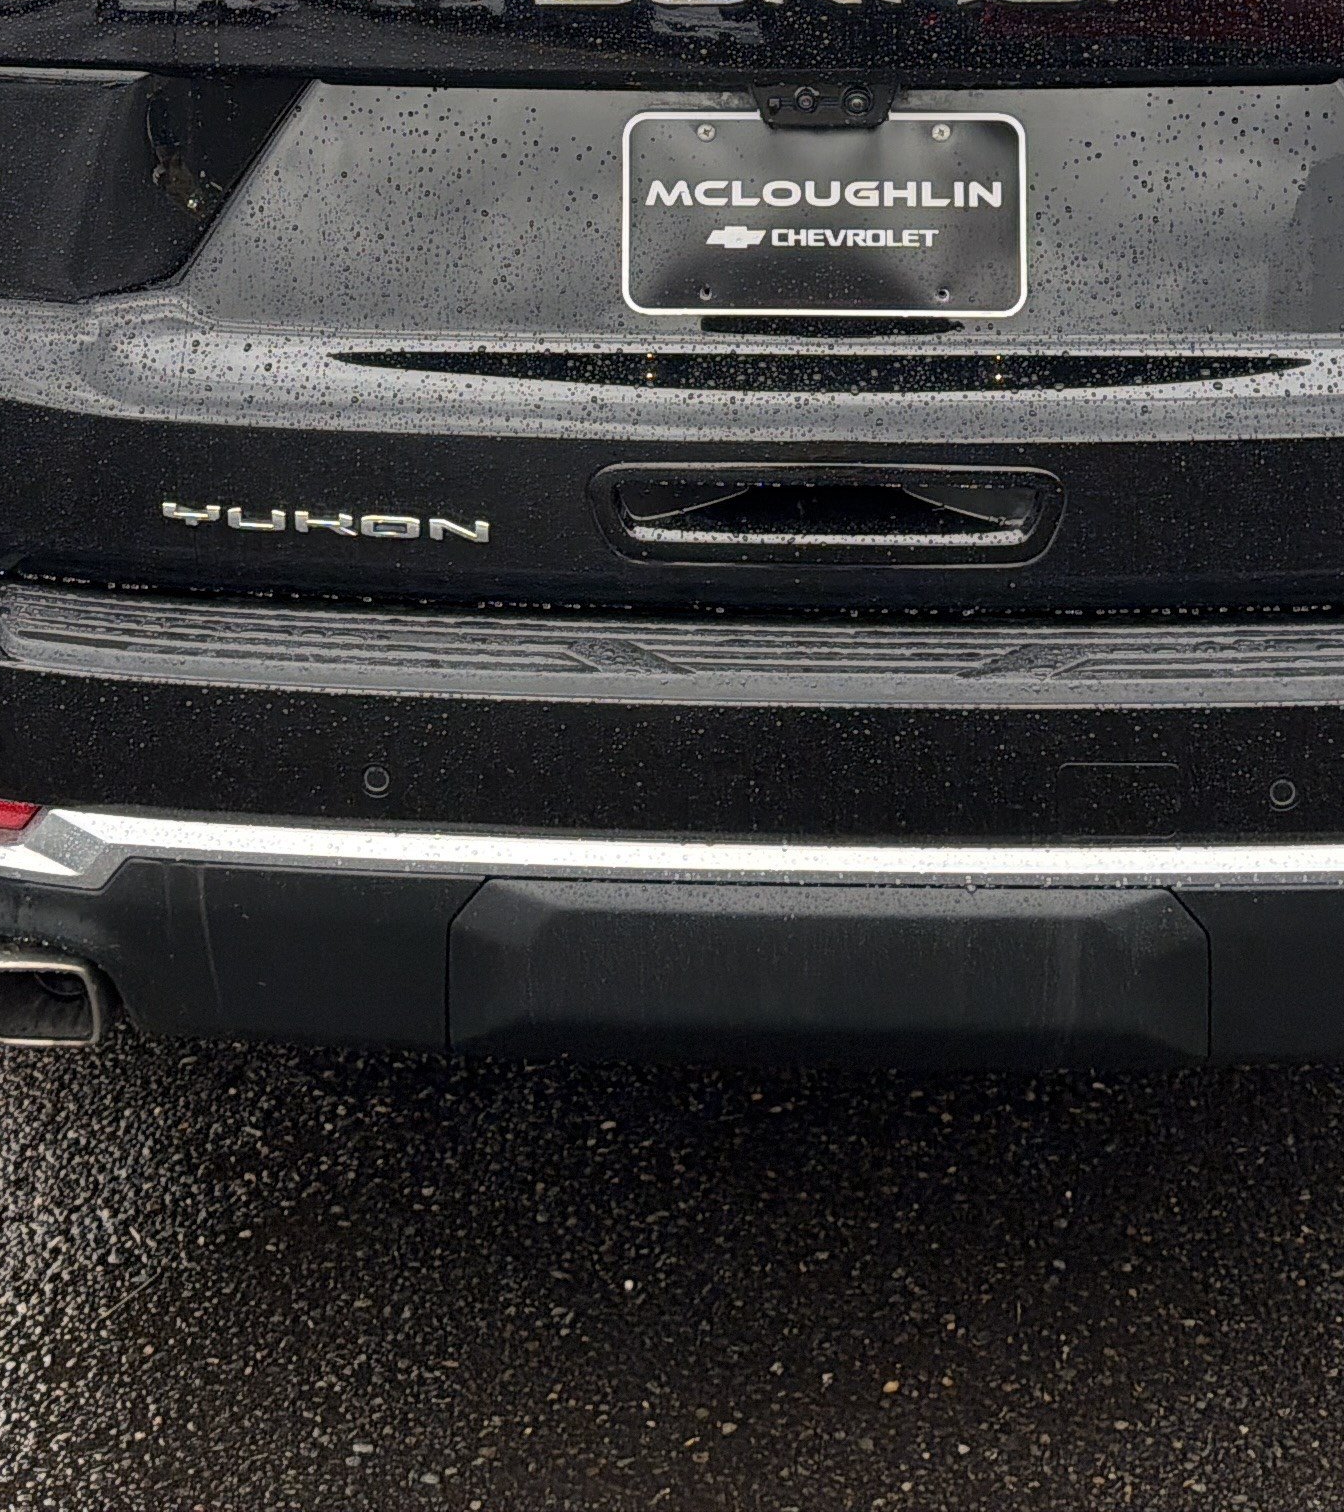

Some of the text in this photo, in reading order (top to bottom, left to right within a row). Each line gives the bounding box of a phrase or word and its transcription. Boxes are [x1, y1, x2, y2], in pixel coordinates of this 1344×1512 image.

[645, 180, 1002, 208] MCLOUGHLIN
[771, 229, 940, 248] CHEVROLET
[162, 502, 489, 542] YUKON
